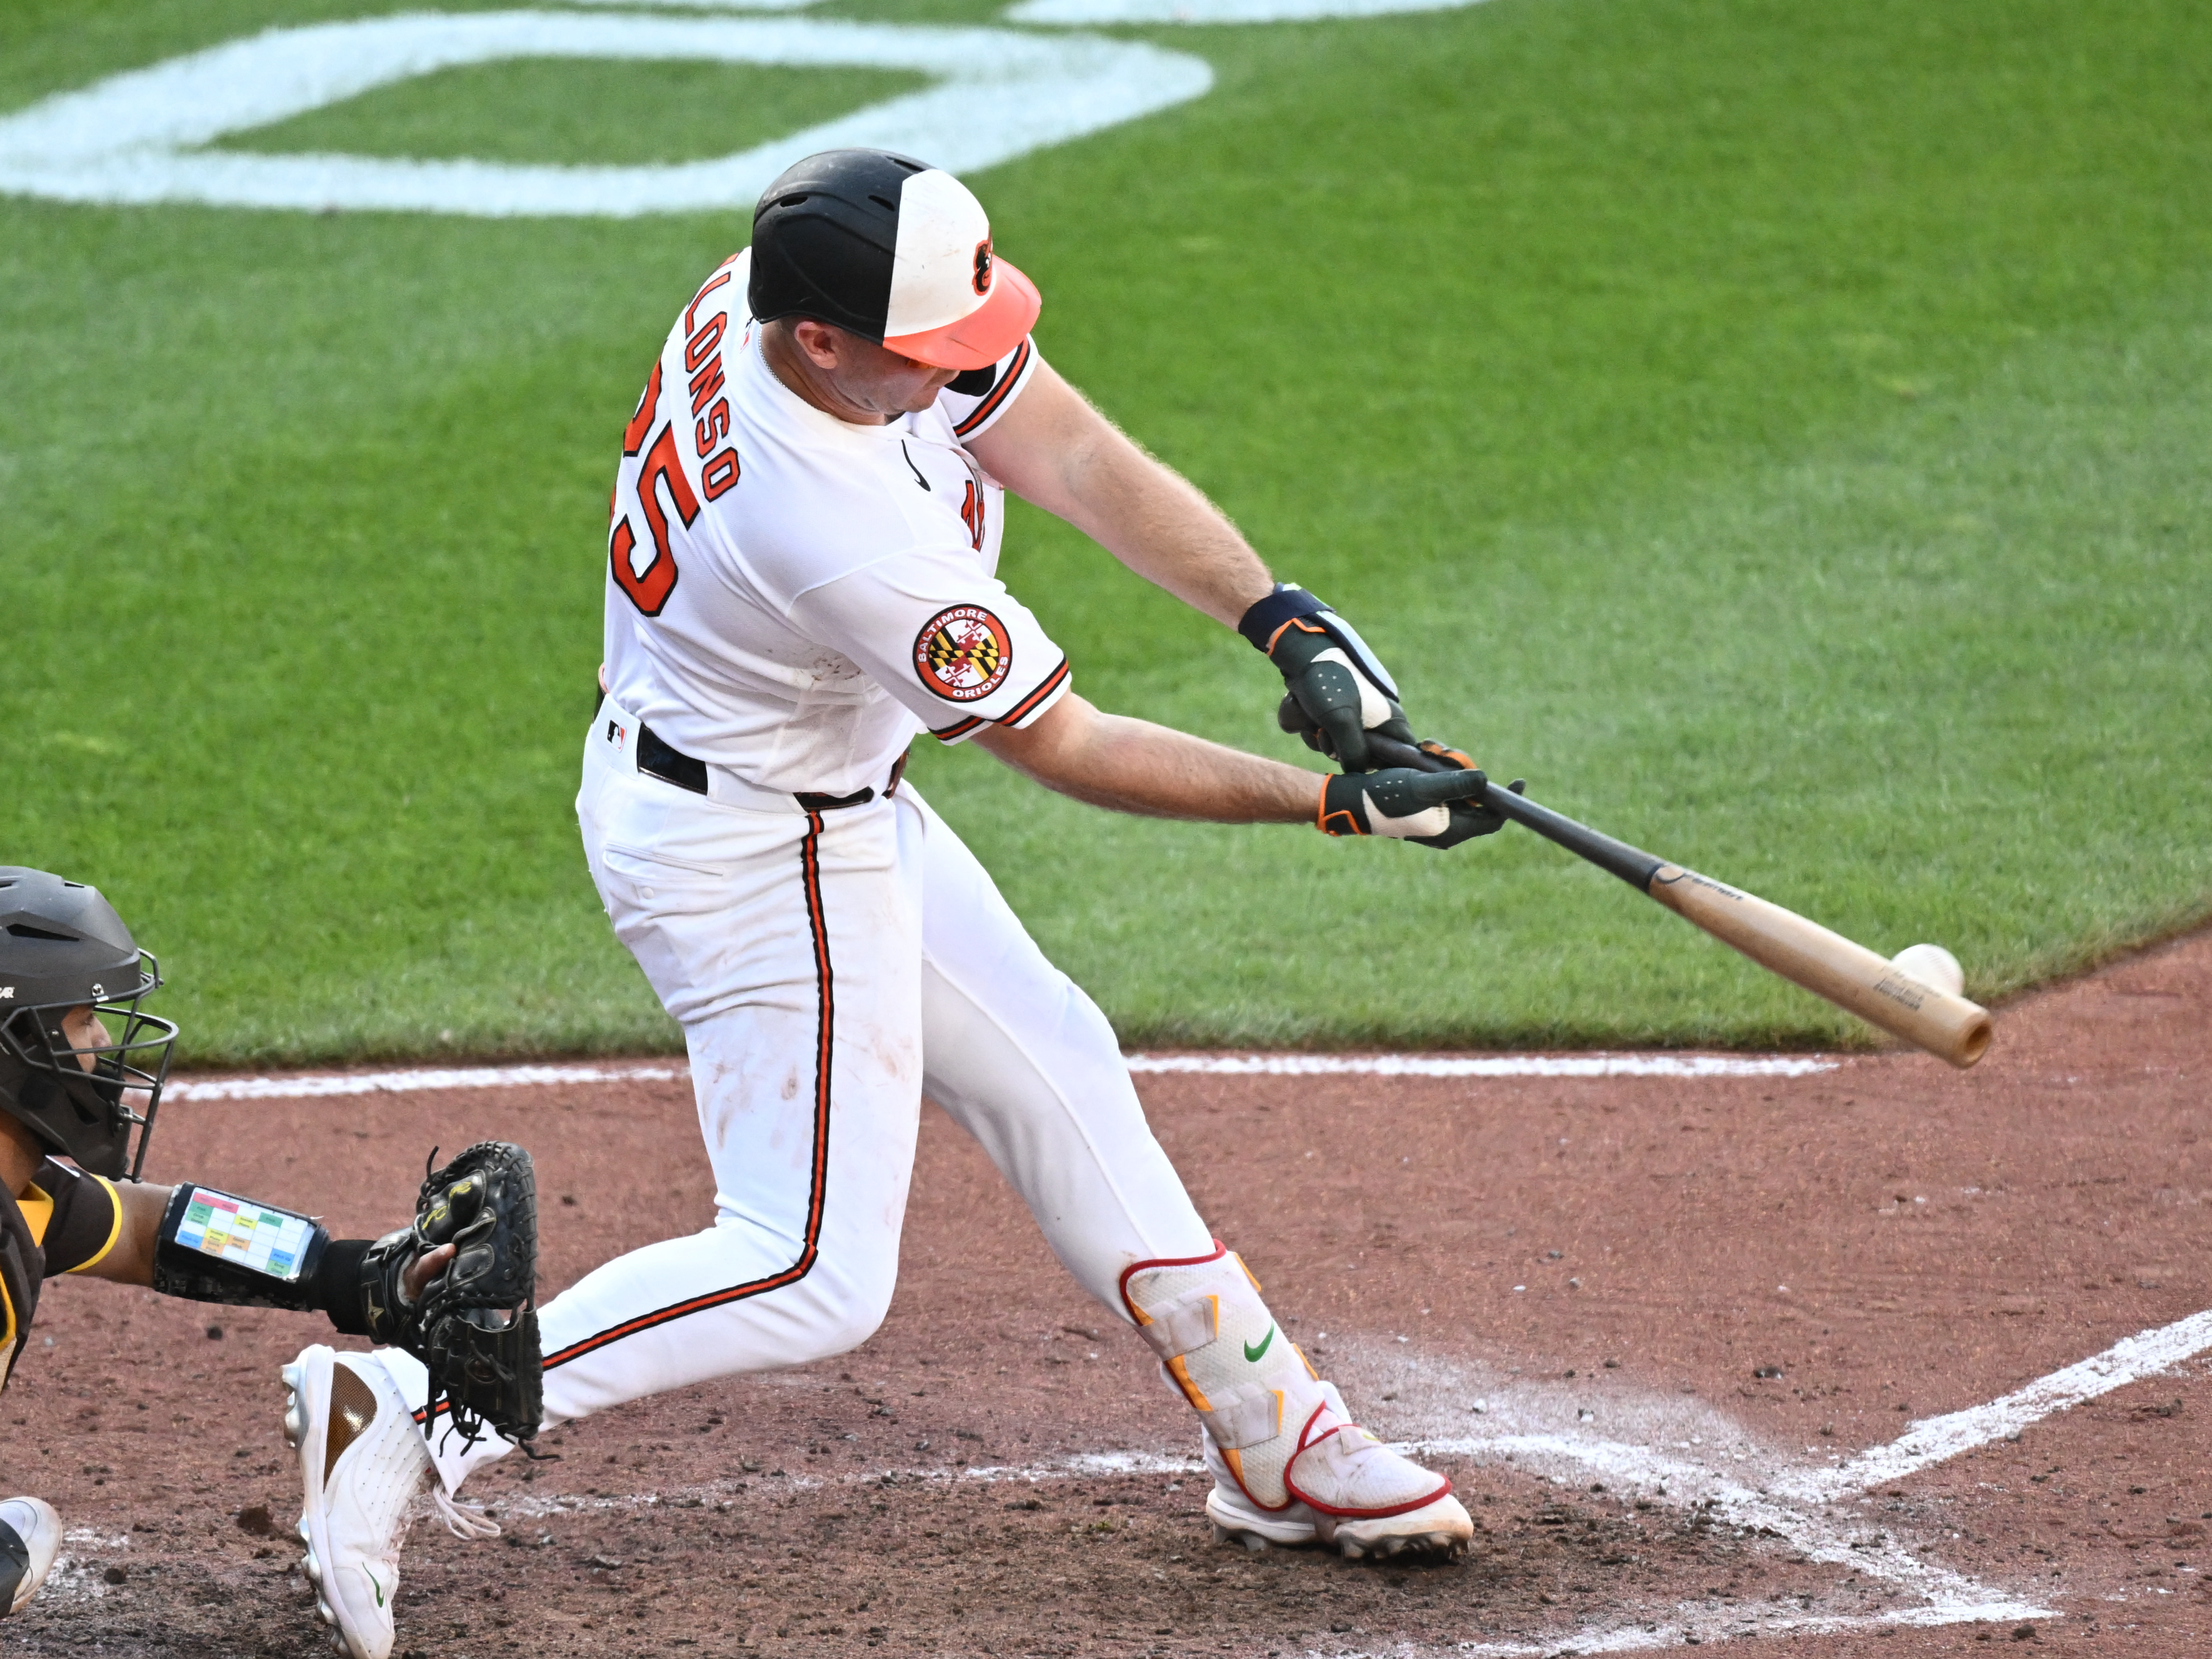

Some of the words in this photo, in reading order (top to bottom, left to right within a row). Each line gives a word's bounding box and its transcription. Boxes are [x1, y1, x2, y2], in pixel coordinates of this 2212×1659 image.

[685, 253, 740, 503] LONSO
[918, 609, 987, 662] BALTIMORE
[953, 656, 1008, 698] ORIOLES
[0, 987, 14, 998] AR
